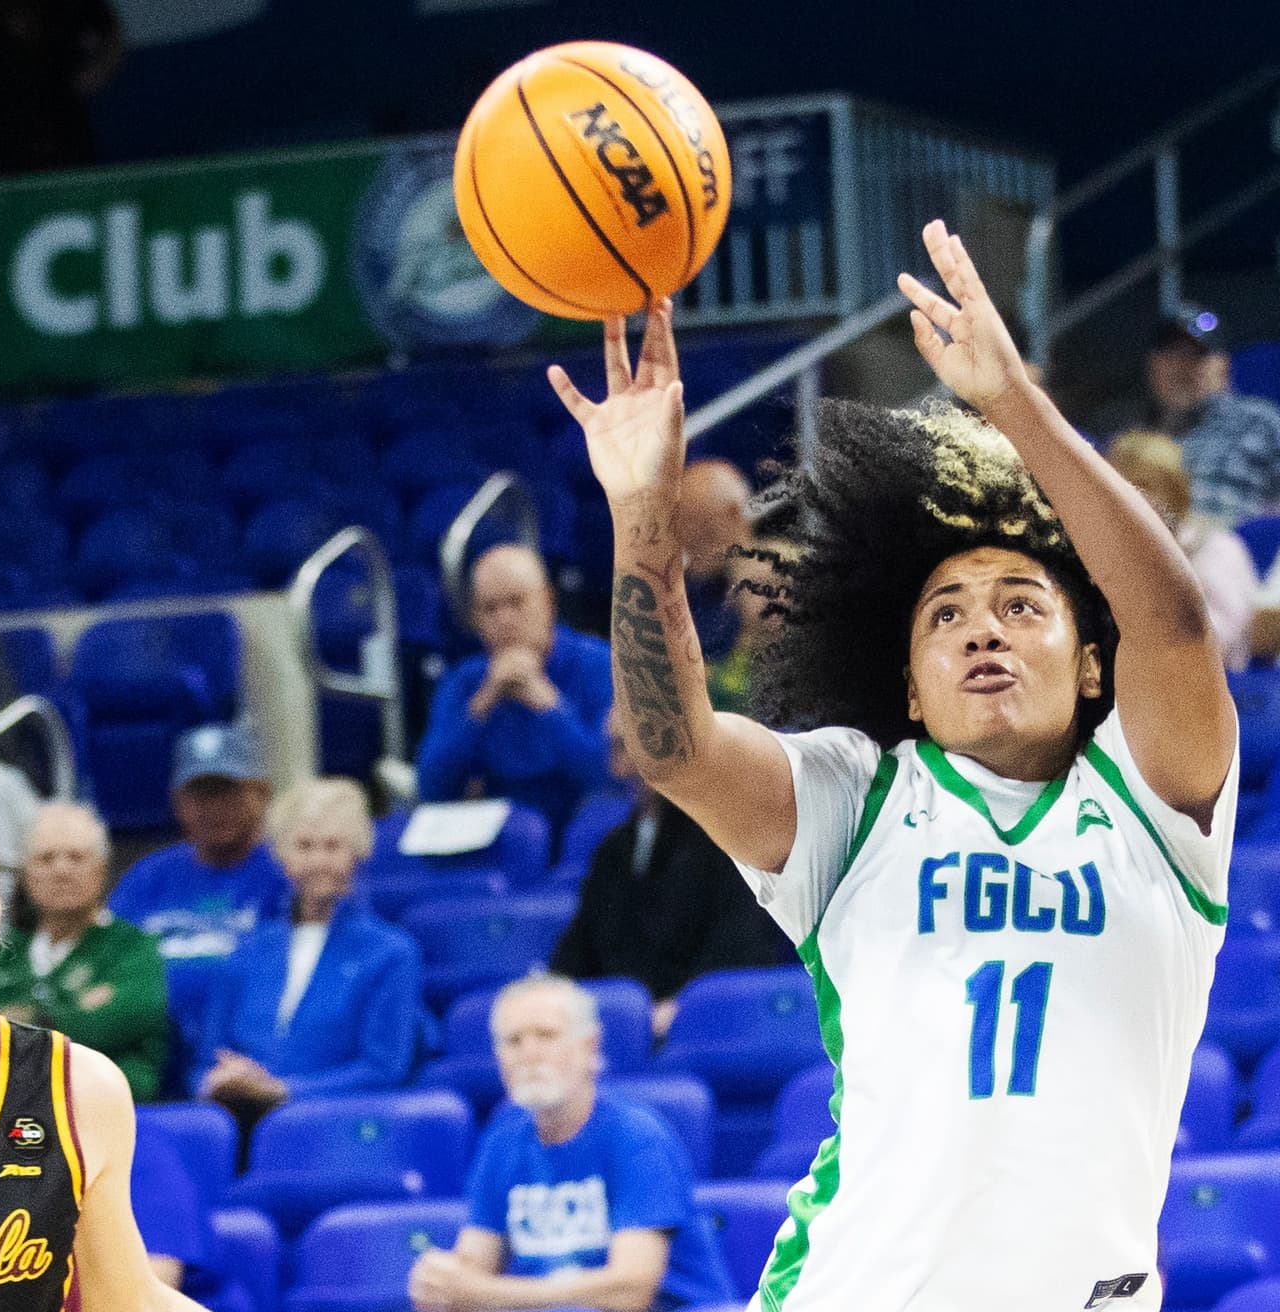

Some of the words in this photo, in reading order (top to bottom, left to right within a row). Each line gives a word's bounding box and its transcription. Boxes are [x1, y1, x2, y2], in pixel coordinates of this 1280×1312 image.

[569, 101, 670, 229] NCAA
[9, 191, 326, 336] Club
[918, 850, 1107, 938] FGCU
[964, 959, 1055, 1100] 11
